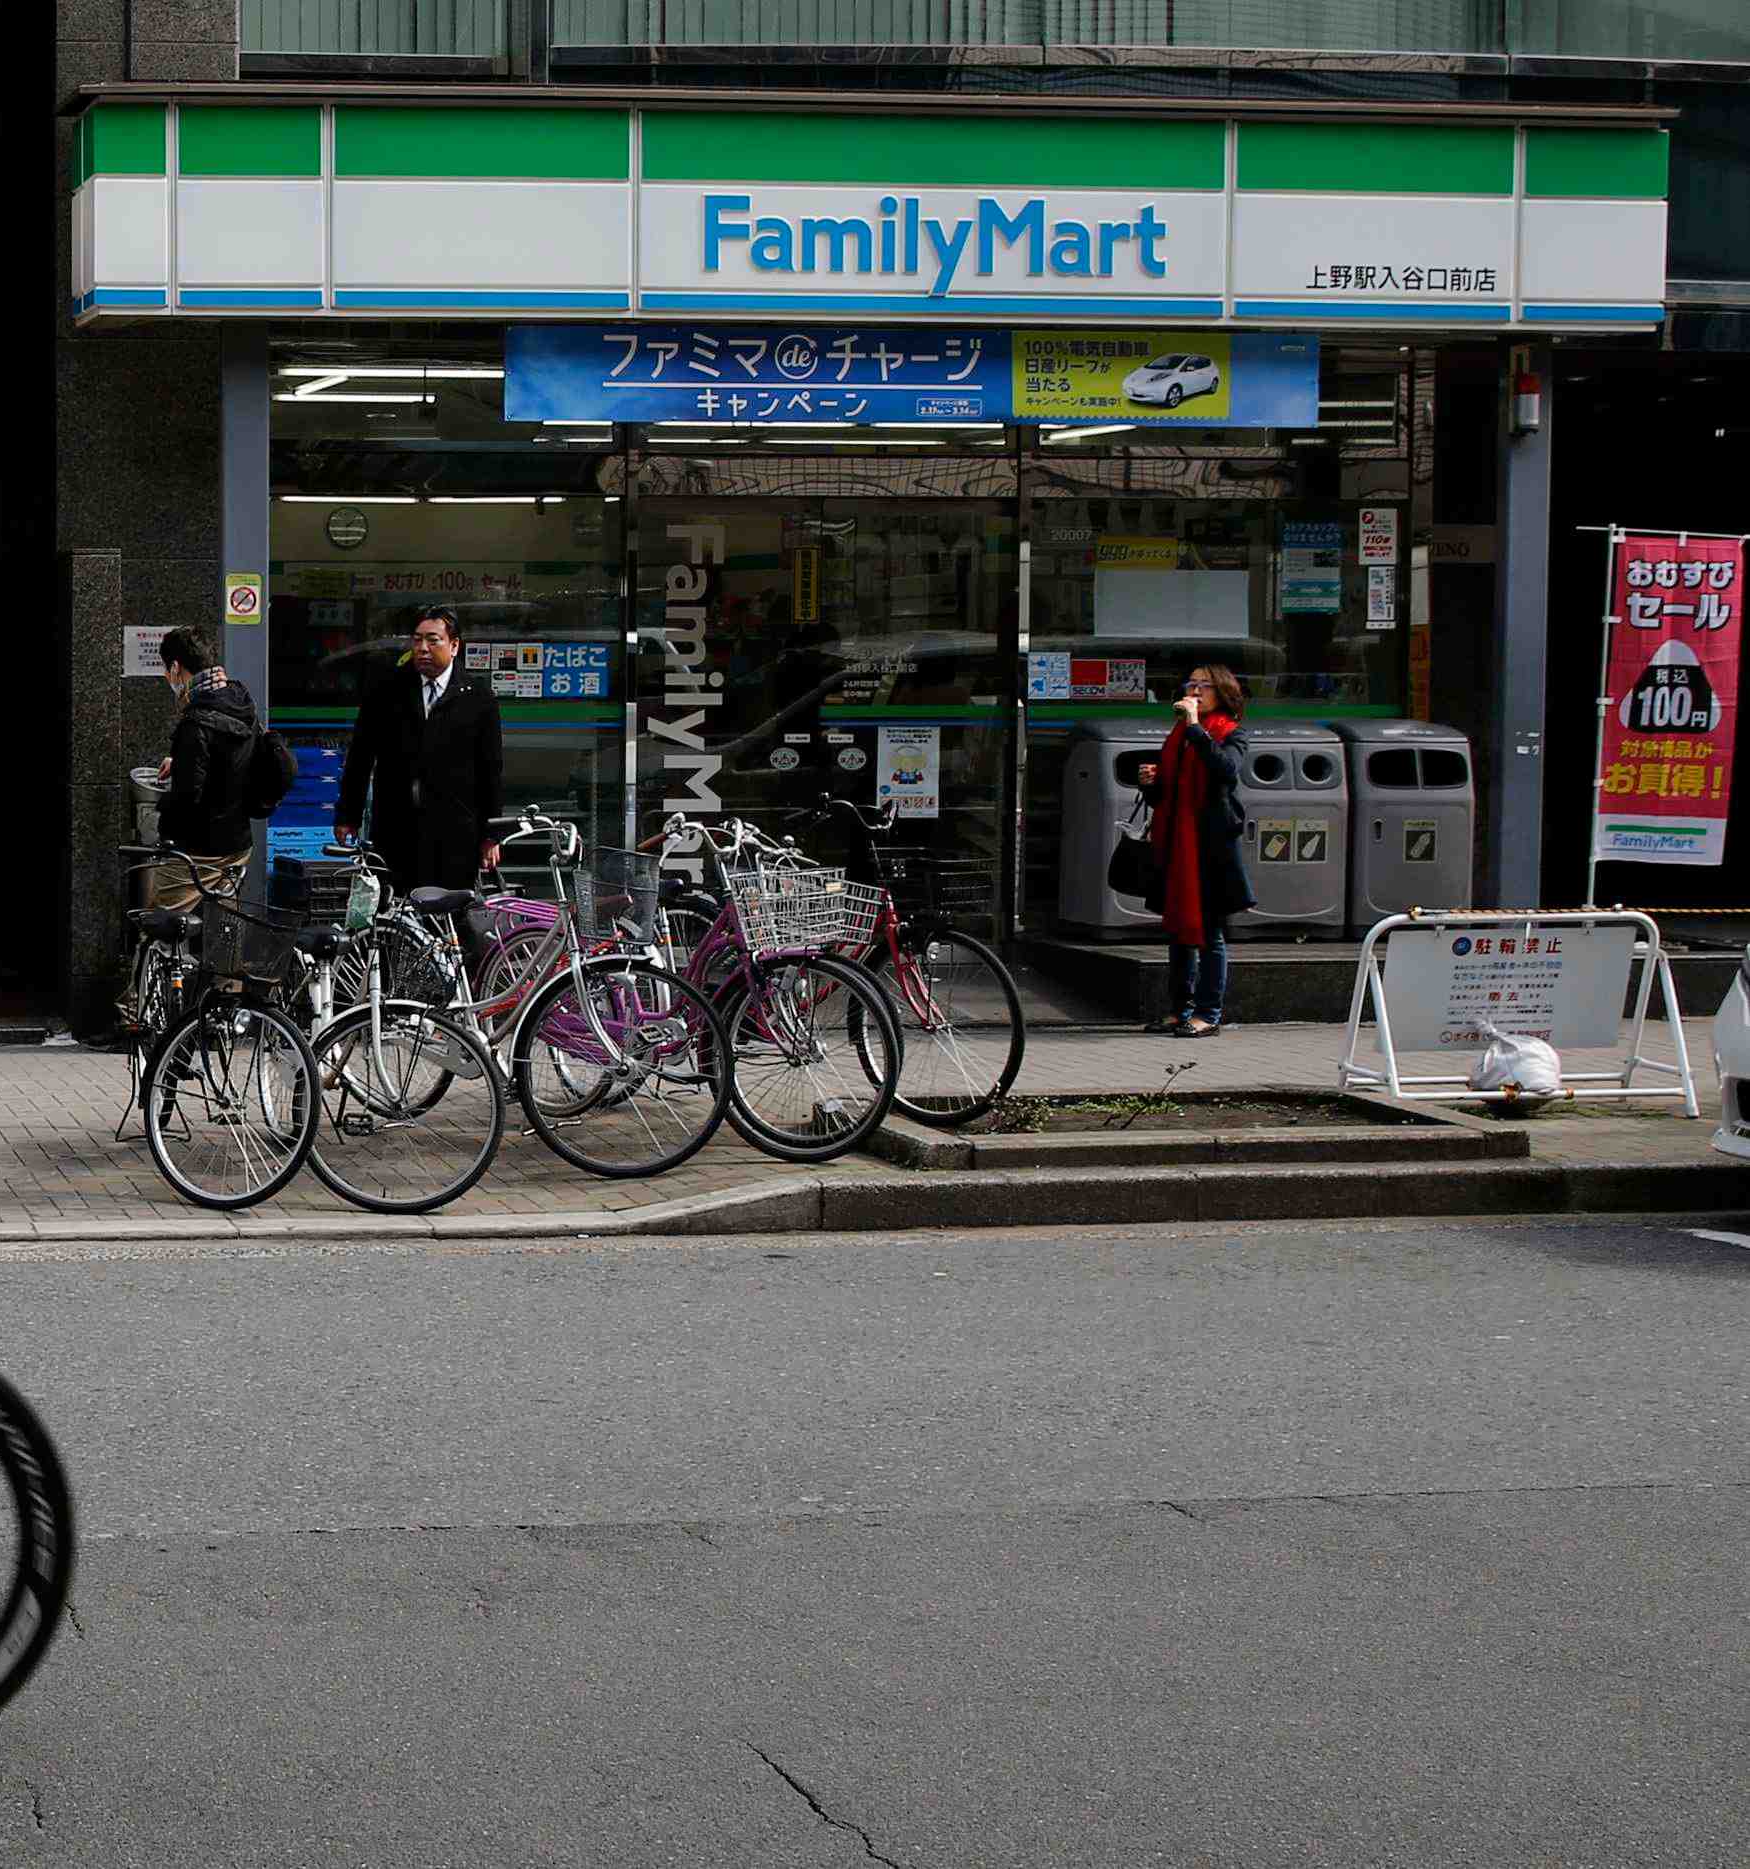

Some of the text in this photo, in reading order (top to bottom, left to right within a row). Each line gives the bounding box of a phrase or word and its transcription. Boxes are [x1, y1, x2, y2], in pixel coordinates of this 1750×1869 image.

[702, 193, 1167, 297] FamilyMart
[1305, 265, 1497, 292] 上野駅入谷口前店
[1025, 358, 1111, 374] 日産リーフが
[1025, 377, 1071, 392] 当たる
[695, 389, 869, 417] キャンペーン
[1626, 559, 1736, 589] おむすび
[1626, 592, 1732, 630] セール
[545, 645, 608, 668] たばこ
[550, 671, 601, 695] お酒
[648, 523, 727, 898] FamilyMar
[1638, 685, 1708, 728] 100円
[1603, 762, 1724, 800] お買得!
[1612, 833, 1695, 850] FamilyMart
